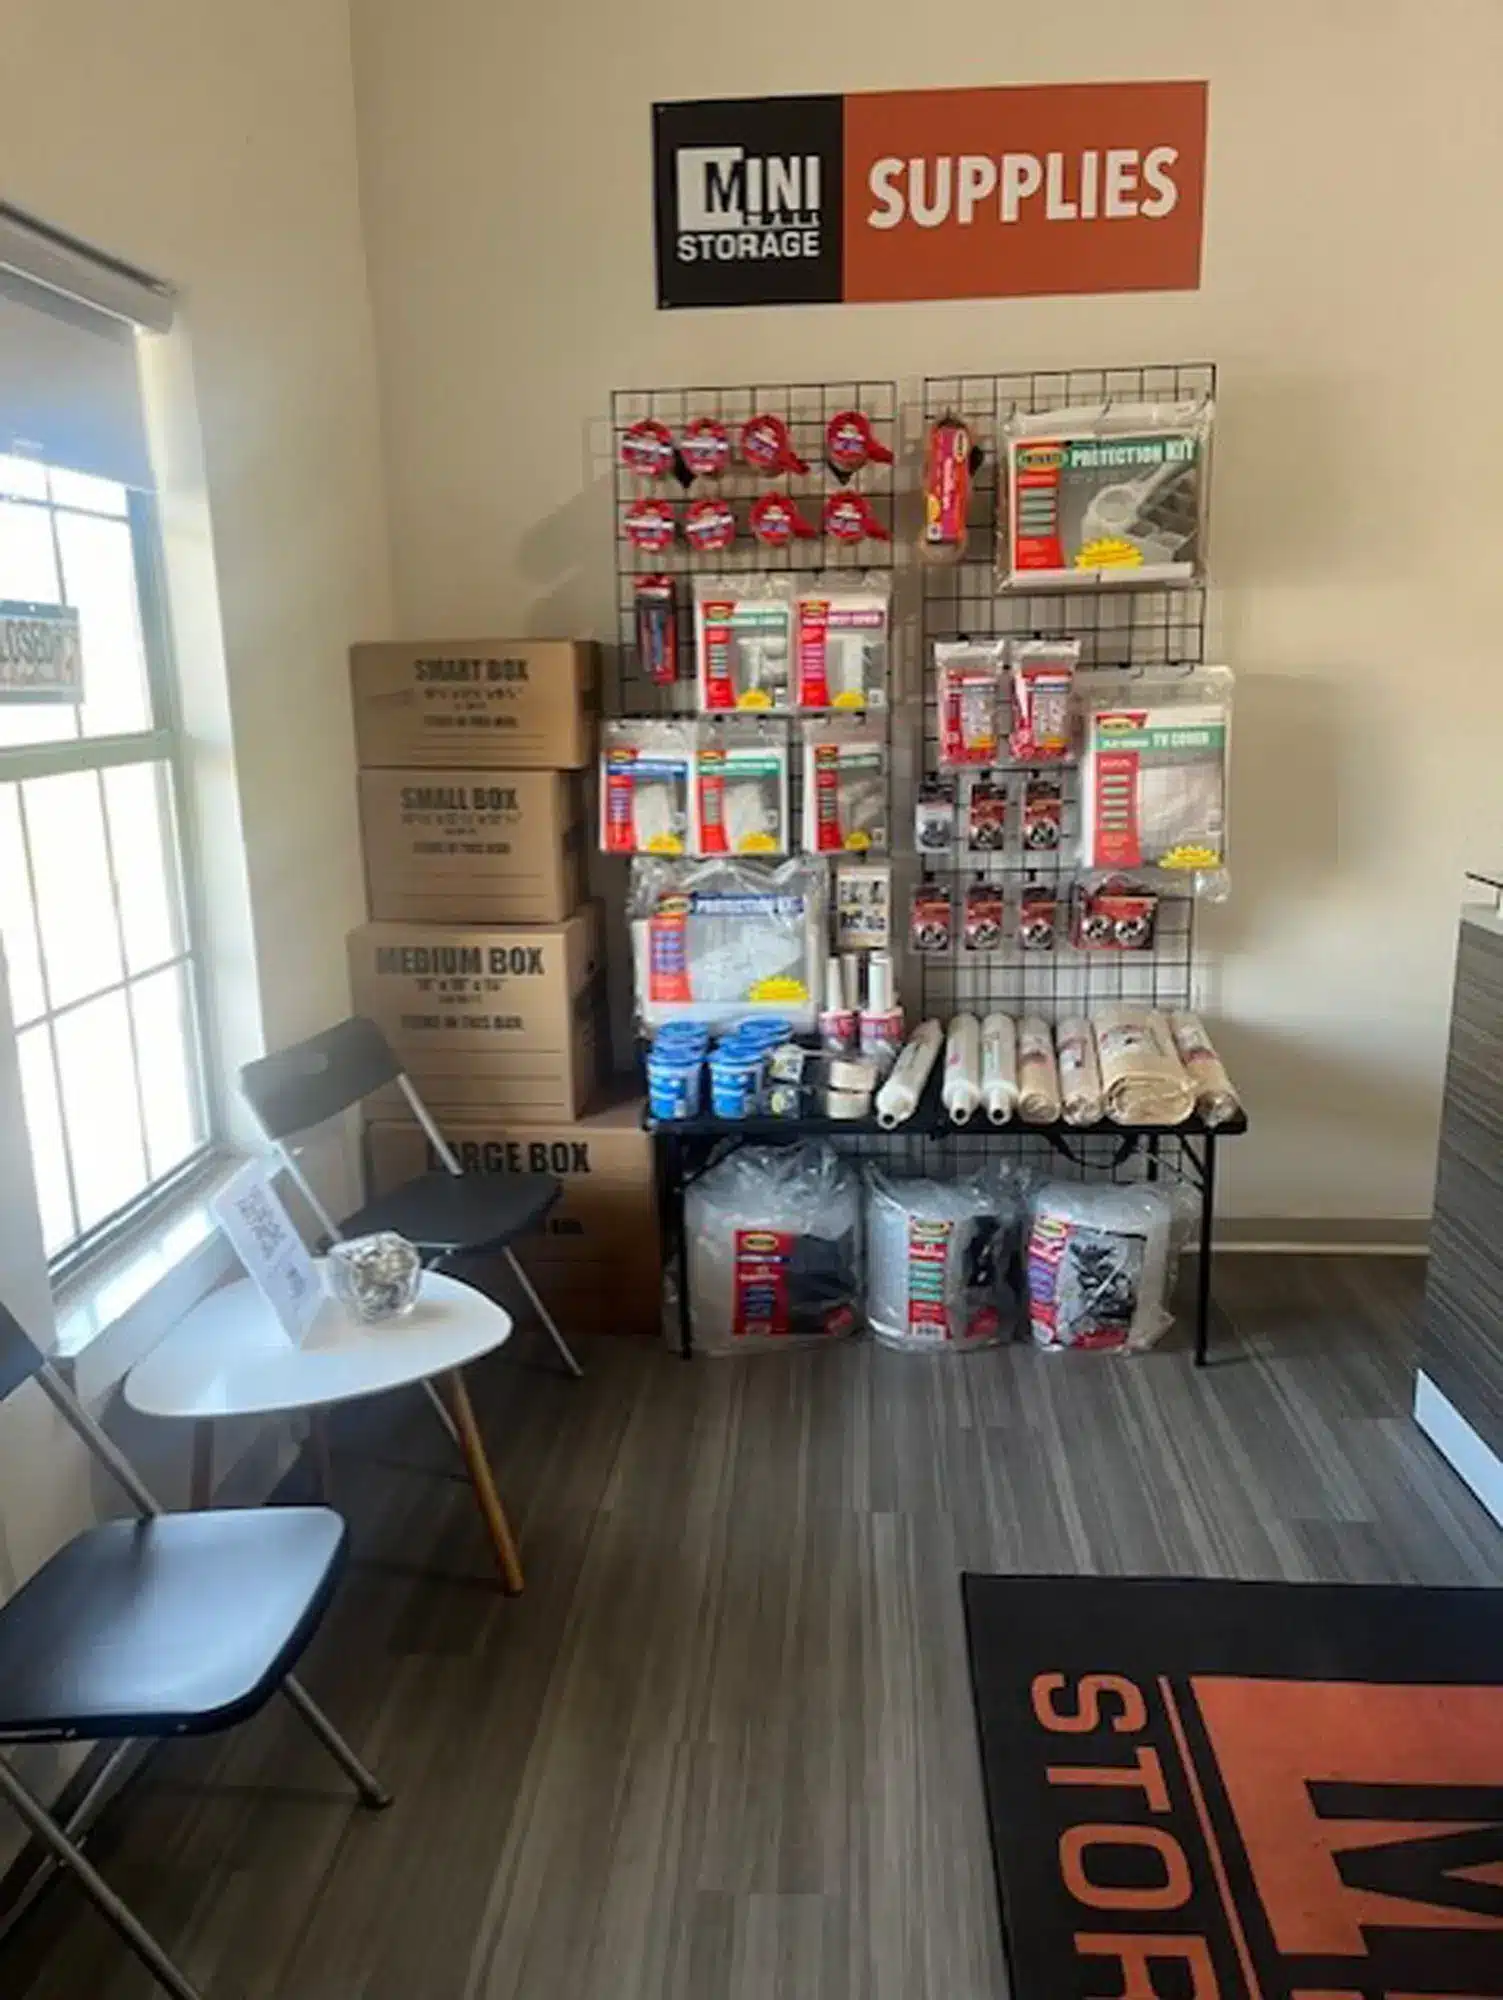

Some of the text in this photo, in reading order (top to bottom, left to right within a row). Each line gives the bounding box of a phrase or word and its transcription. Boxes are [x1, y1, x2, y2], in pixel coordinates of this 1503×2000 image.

[704, 156, 820, 214] MINI
[866, 146, 1179, 230] SUPPLIES
[677, 231, 820, 261] STORAGE
[473, 786, 519, 810] BOX
[376, 946, 545, 975] MEDIUM BOX
[529, 1141, 592, 1173] BOX
